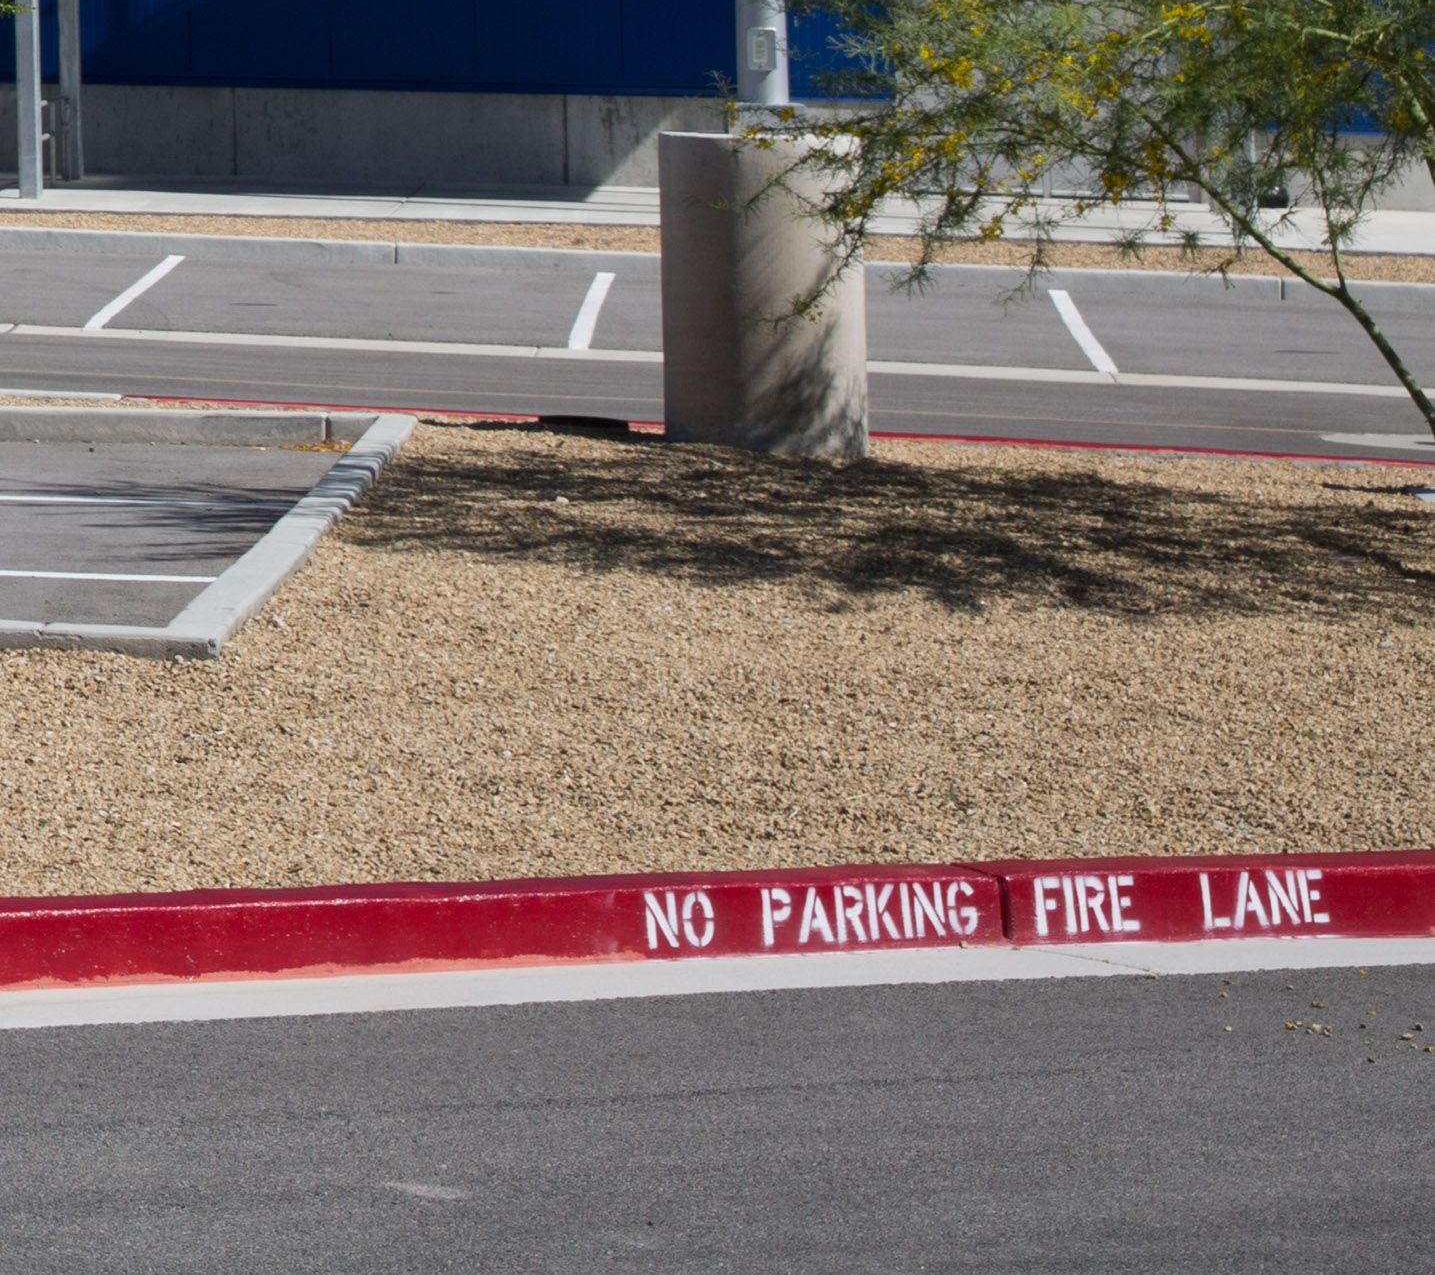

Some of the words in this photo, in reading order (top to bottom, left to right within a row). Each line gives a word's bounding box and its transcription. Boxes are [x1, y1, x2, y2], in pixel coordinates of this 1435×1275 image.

[643, 889, 716, 950] NO
[760, 879, 979, 948] PARKING
[1032, 874, 1143, 937] FIRE
[1199, 868, 1332, 928] LANE
